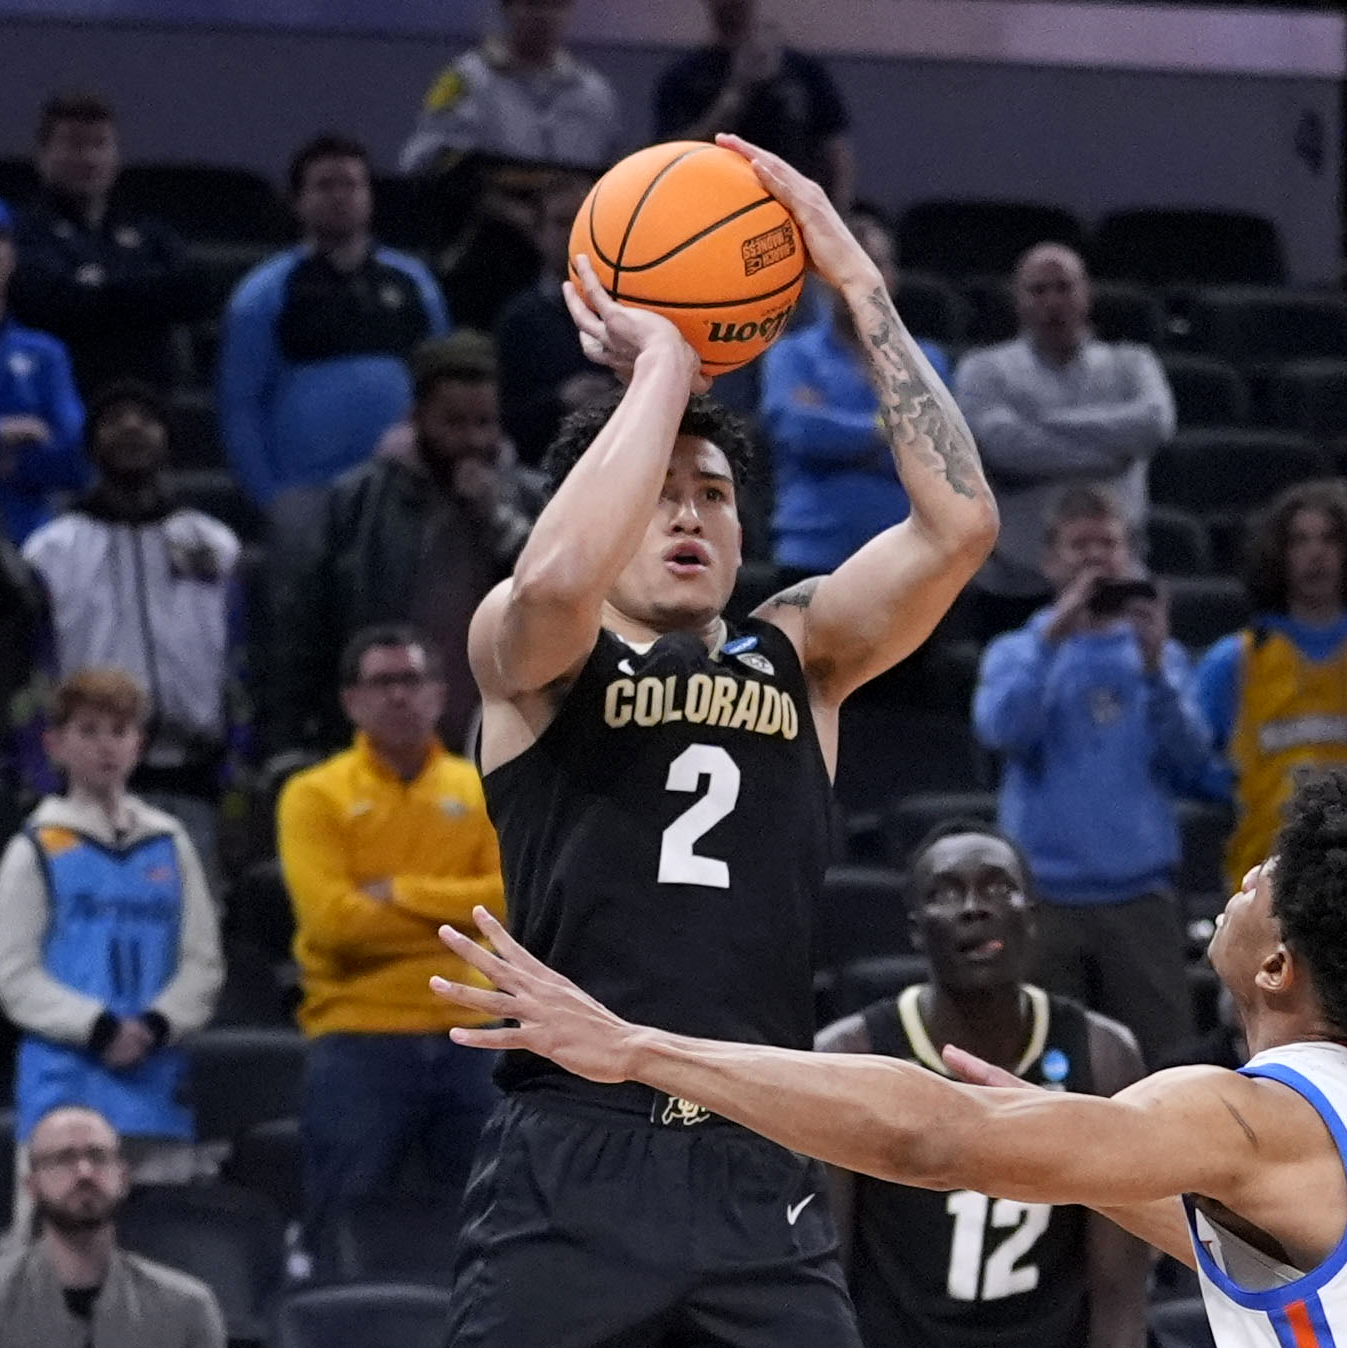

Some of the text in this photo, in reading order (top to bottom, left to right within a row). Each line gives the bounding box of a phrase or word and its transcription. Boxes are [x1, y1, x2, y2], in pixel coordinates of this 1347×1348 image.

[605, 673, 799, 740] COLORADO
[657, 743, 741, 889] 2
[946, 1190, 1052, 1301] 12
